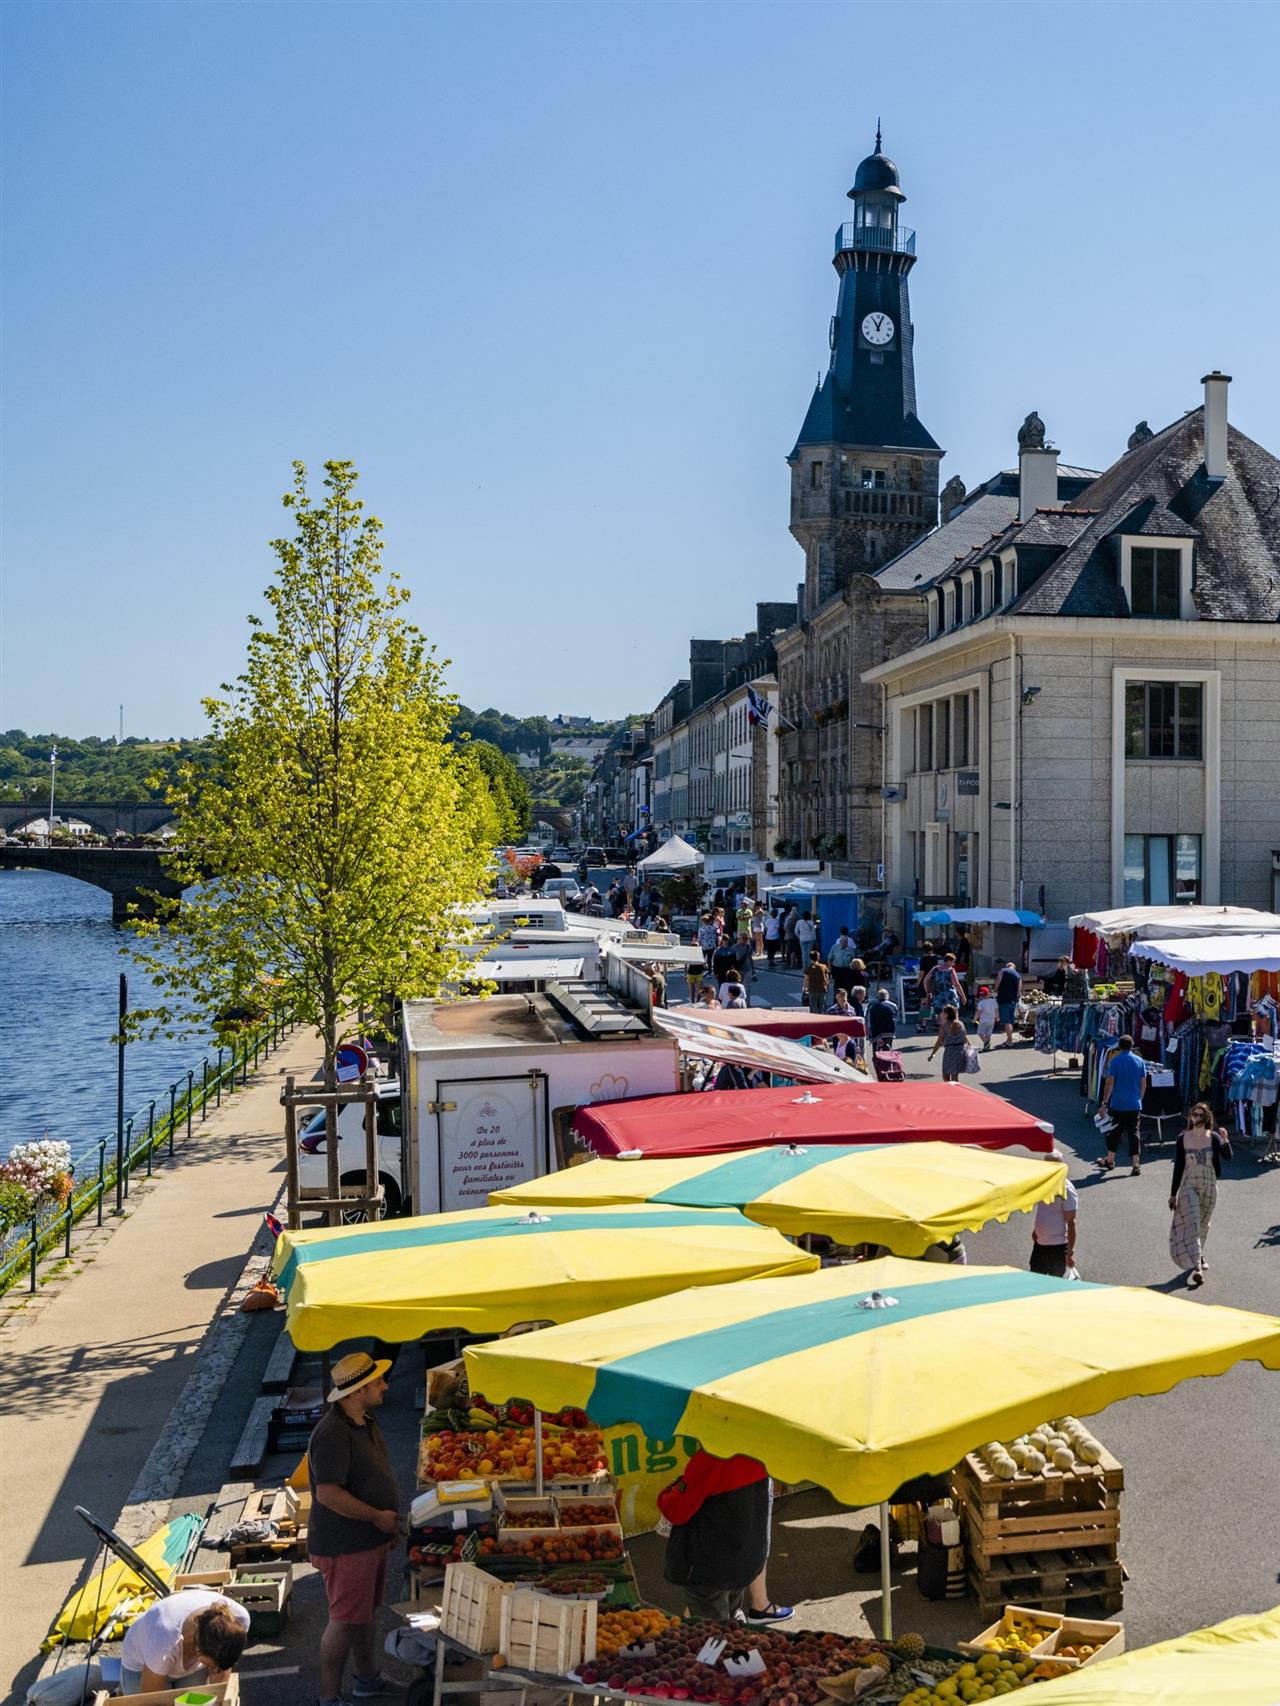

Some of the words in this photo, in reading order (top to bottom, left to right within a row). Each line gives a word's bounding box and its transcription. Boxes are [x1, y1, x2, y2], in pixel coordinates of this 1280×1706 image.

[476, 1126, 488, 1134] De
[490, 1125, 501, 1134] 20
[478, 1138, 495, 1147] plus
[497, 1137, 507, 1145] de
[458, 1151, 478, 1159] 3000
[480, 1149, 519, 1160] personnes
[452, 1164, 471, 1174] pour
[463, 1173, 503, 1185] familiales
